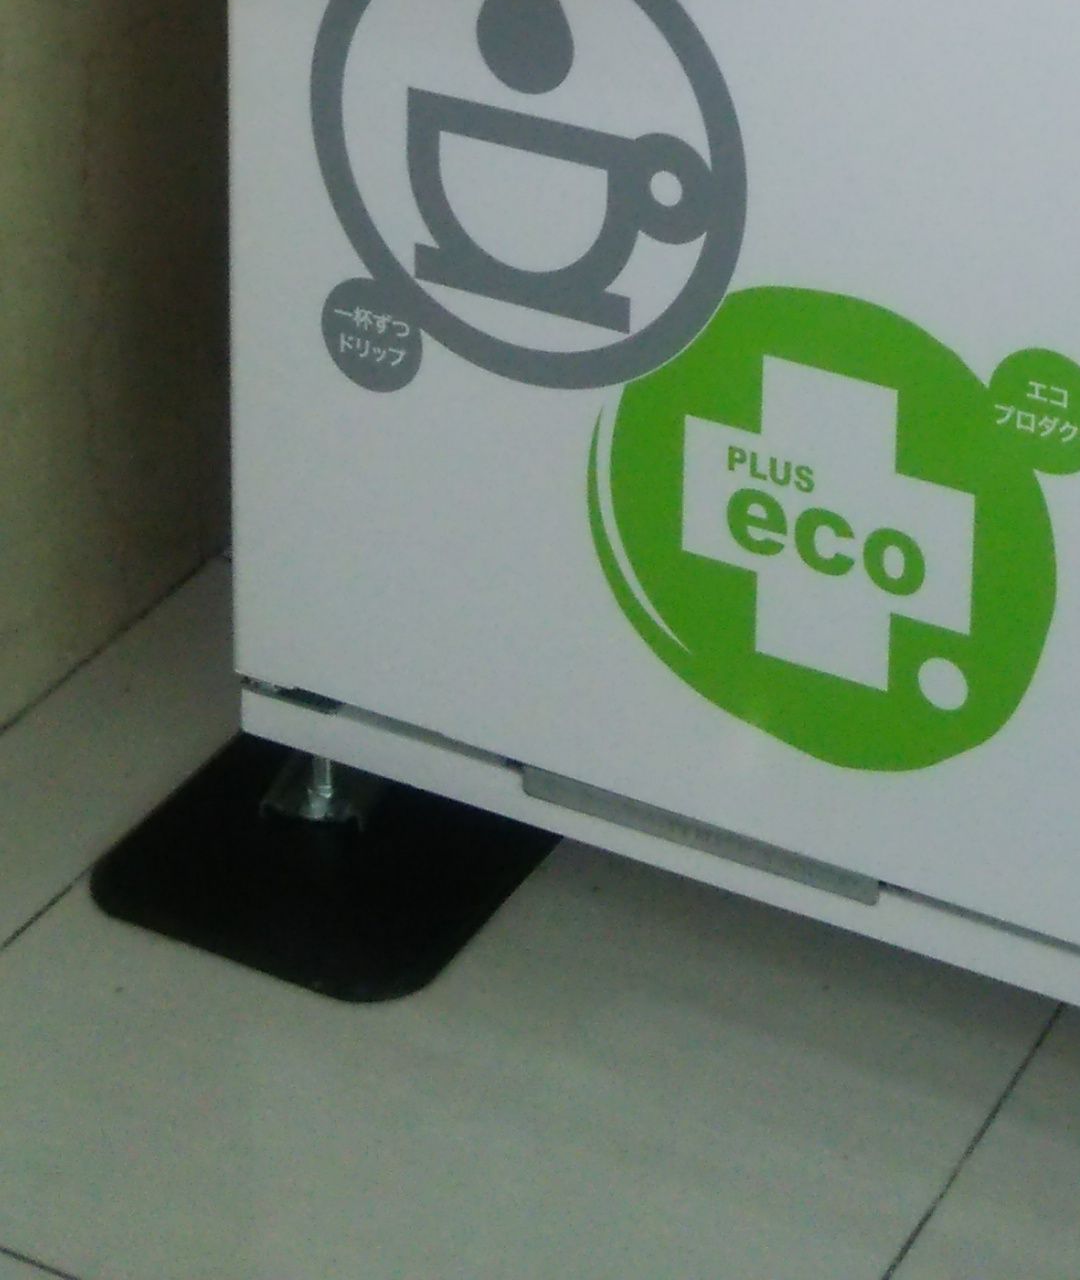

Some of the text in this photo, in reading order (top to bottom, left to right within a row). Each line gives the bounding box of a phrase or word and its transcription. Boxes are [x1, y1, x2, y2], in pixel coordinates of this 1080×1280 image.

[334, 306, 410, 337] 一杯ずつ
[339, 332, 407, 366] ドリップ
[1025, 380, 1069, 409] エコ
[727, 444, 815, 493] PLUS
[726, 487, 926, 596] eco
